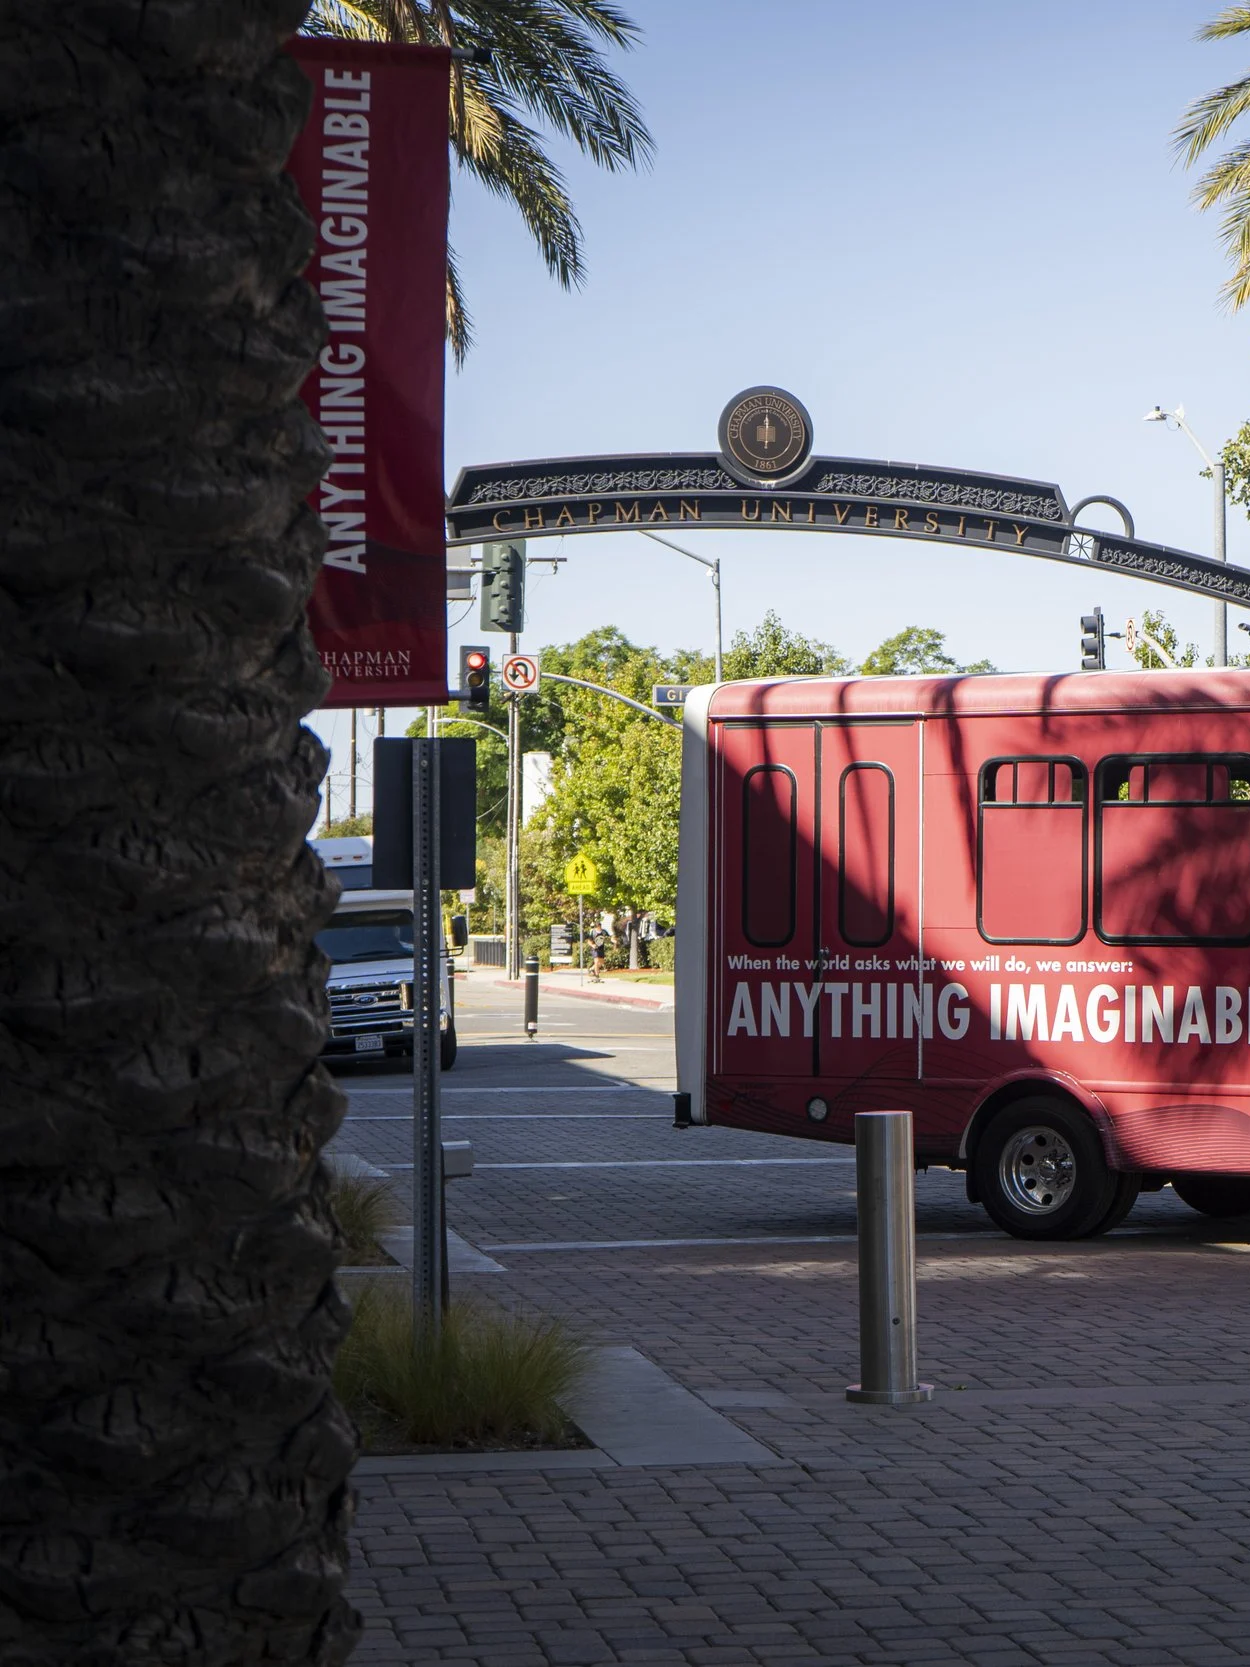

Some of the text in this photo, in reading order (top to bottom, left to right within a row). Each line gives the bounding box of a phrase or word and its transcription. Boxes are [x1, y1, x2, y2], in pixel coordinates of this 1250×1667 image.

[319, 68, 371, 574] ANYTHING IMAGINABLE
[730, 397, 762, 439] CHAPMAN
[765, 397, 802, 441] UNIVERSITY
[755, 460, 777, 469] 1861
[493, 499, 1029, 546] CHAPMAN UNIVERSITY
[317, 650, 411, 665] HAPMAN
[727, 954, 1134, 975] When the world asks what we will do, we answer:
[727, 981, 971, 1041] ANYTHING
